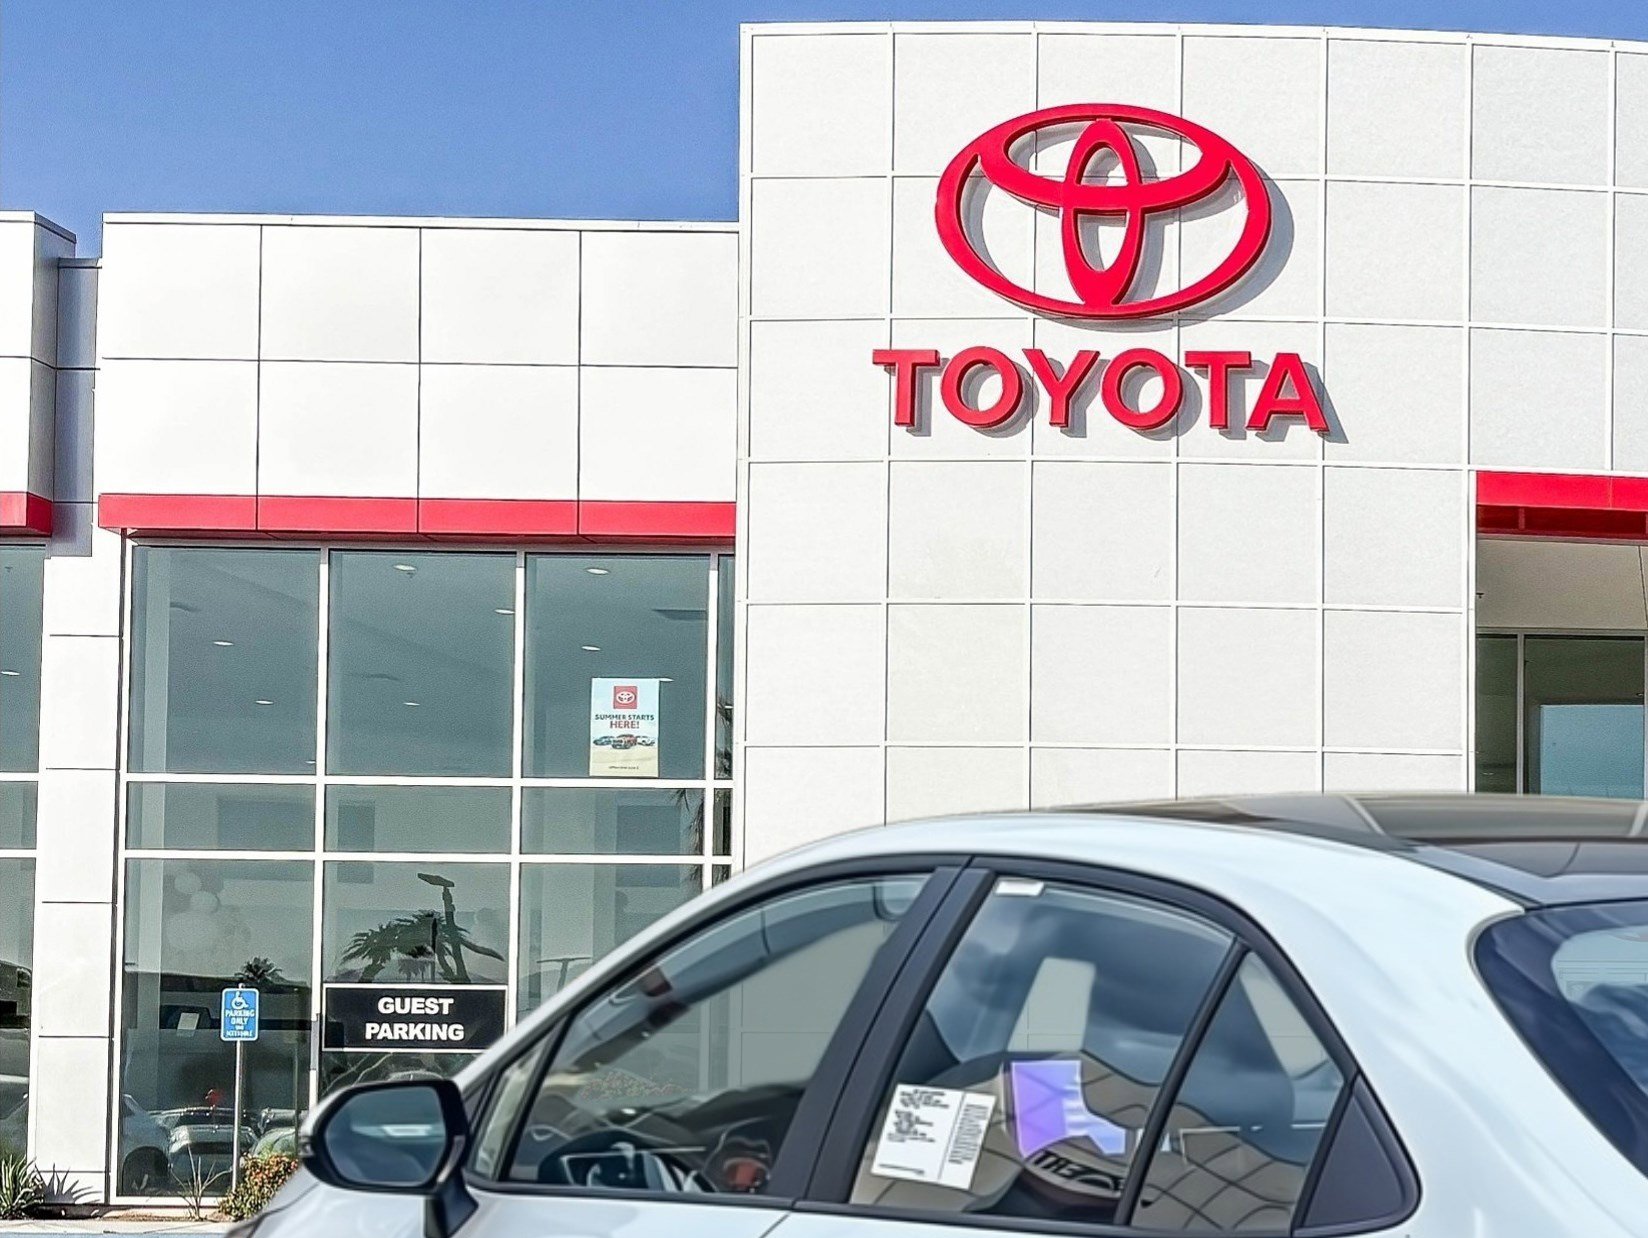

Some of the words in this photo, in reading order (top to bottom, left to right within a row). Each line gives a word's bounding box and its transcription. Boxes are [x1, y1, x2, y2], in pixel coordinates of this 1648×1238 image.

[872, 345, 1329, 433] TOYOTA
[609, 721, 640, 729] HERE!
[377, 997, 454, 1015] GUEST
[365, 1023, 464, 1041] PARKING
